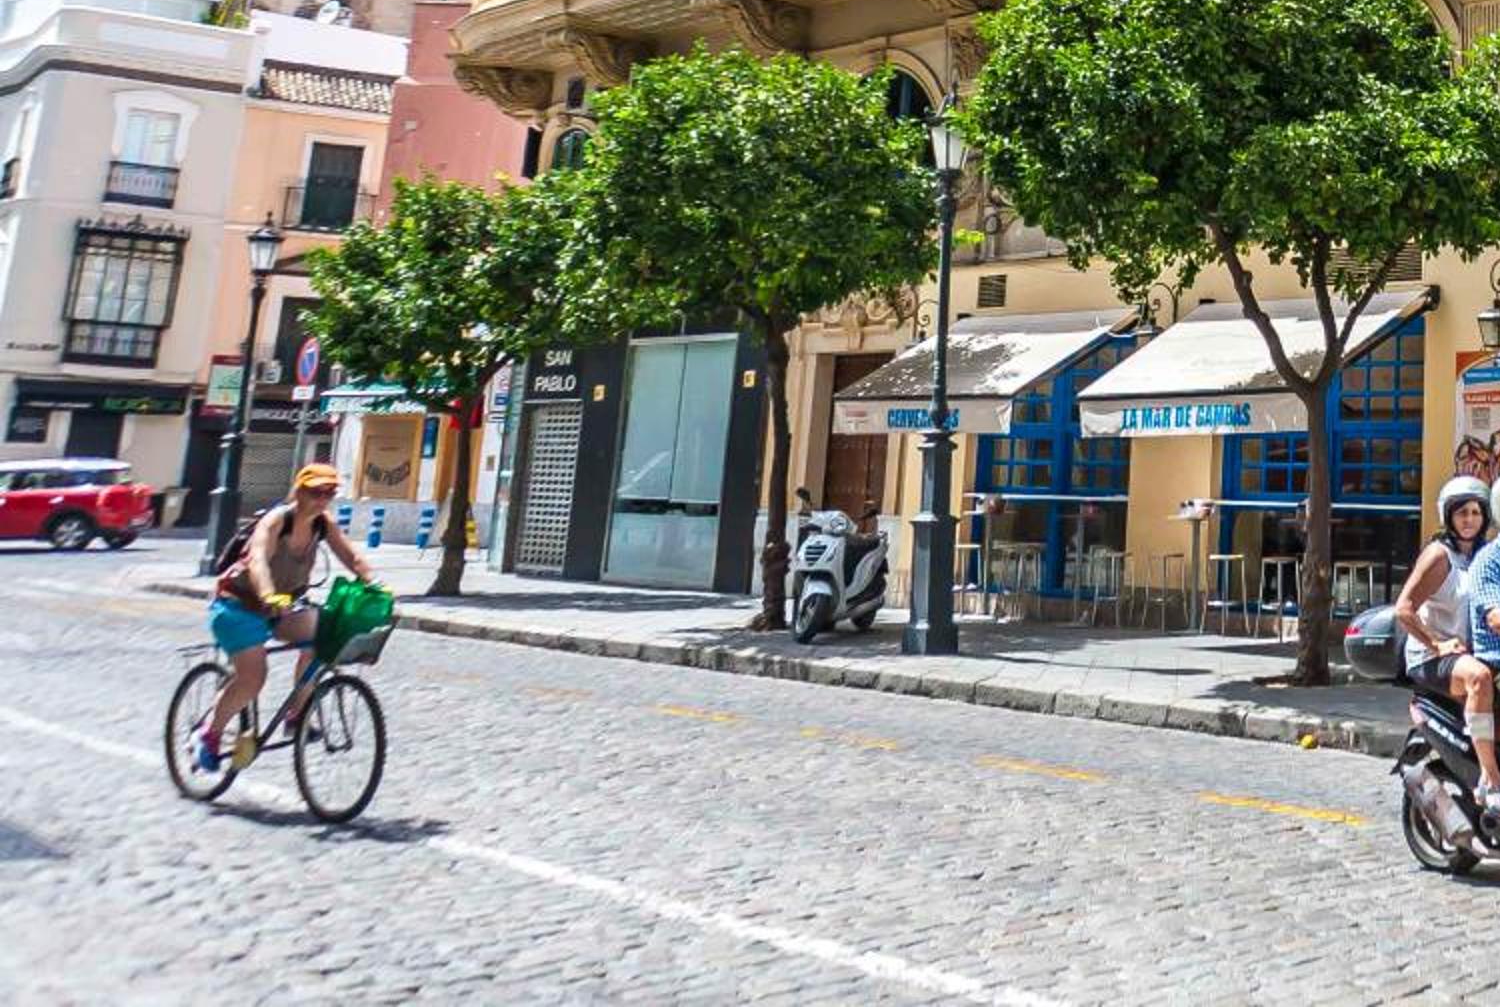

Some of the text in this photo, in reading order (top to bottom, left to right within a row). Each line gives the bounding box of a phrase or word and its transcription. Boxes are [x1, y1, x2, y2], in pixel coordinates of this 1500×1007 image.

[545, 350, 572, 366] SAN
[534, 374, 577, 392] PABLO
[1122, 401, 1251, 430] LA MAR DE GAMBAS
